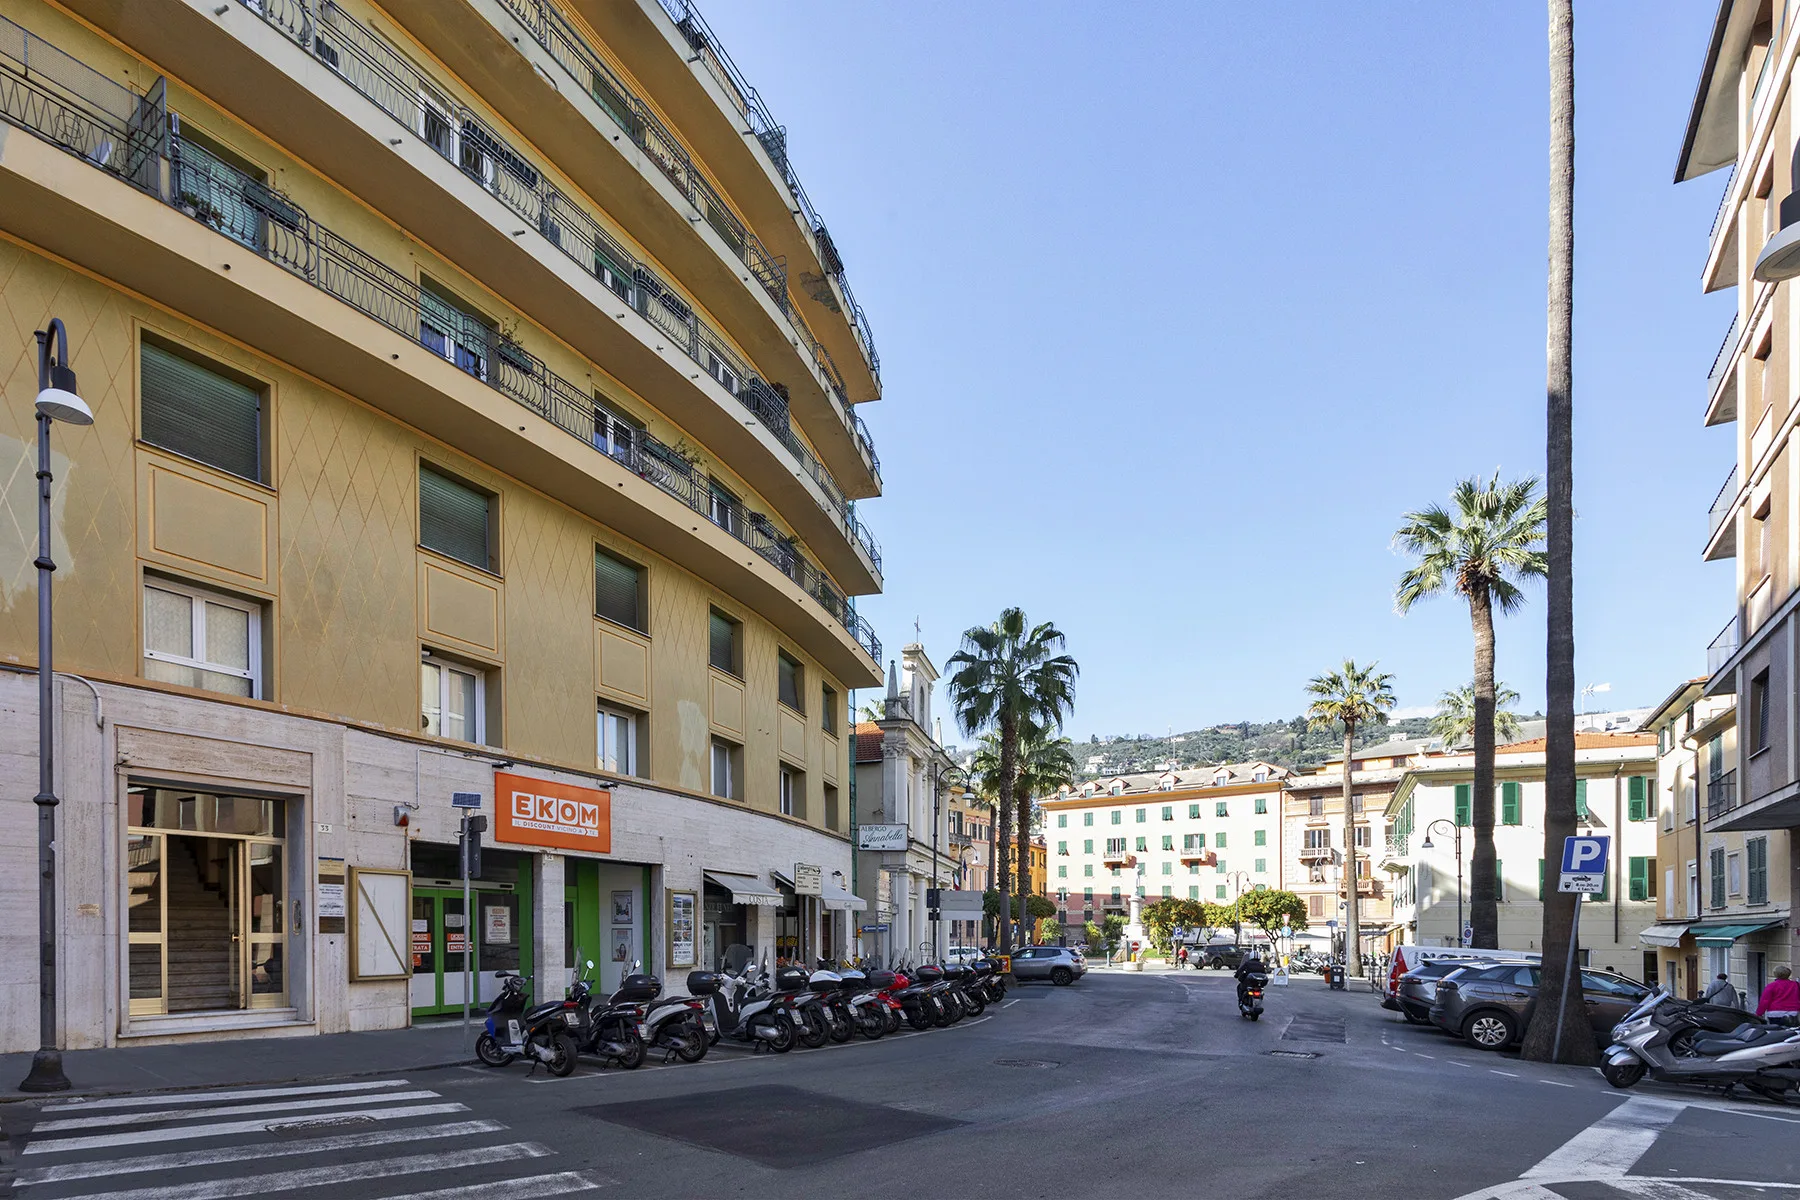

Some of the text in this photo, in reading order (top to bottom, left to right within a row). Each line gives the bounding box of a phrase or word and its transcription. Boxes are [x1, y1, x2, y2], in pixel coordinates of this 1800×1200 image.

[516, 795, 597, 826] EKOM
[320, 824, 330, 832] 33
[523, 821, 555, 830] DISCOUNT
[557, 825, 577, 833] VICINO
[863, 829, 904, 843] Annabella
[1571, 840, 1601, 870] P
